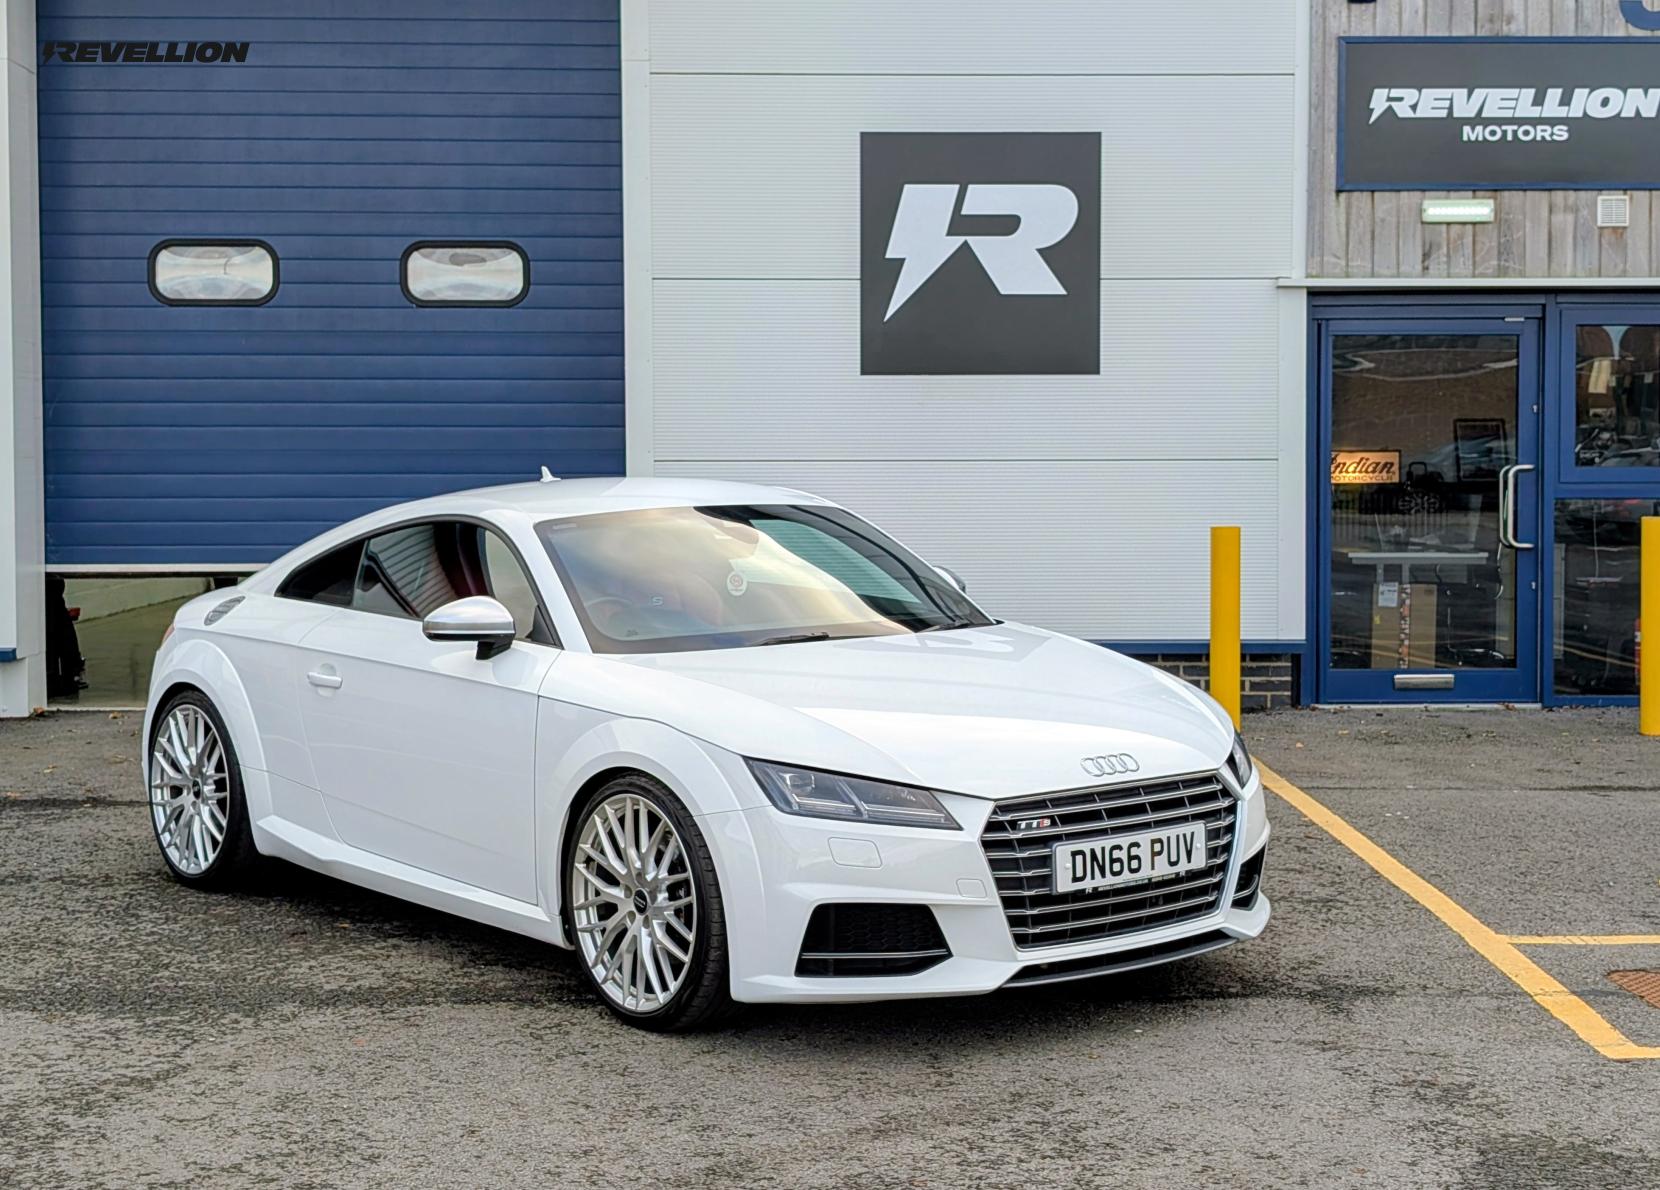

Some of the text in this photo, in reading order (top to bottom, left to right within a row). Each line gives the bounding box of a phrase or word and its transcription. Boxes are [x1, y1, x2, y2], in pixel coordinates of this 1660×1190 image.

[1368, 87, 1660, 124] REVELLION
[1462, 125, 1569, 142] MOTORS
[883, 183, 1079, 322] R
[1070, 830, 1196, 884] DN66 PUV
